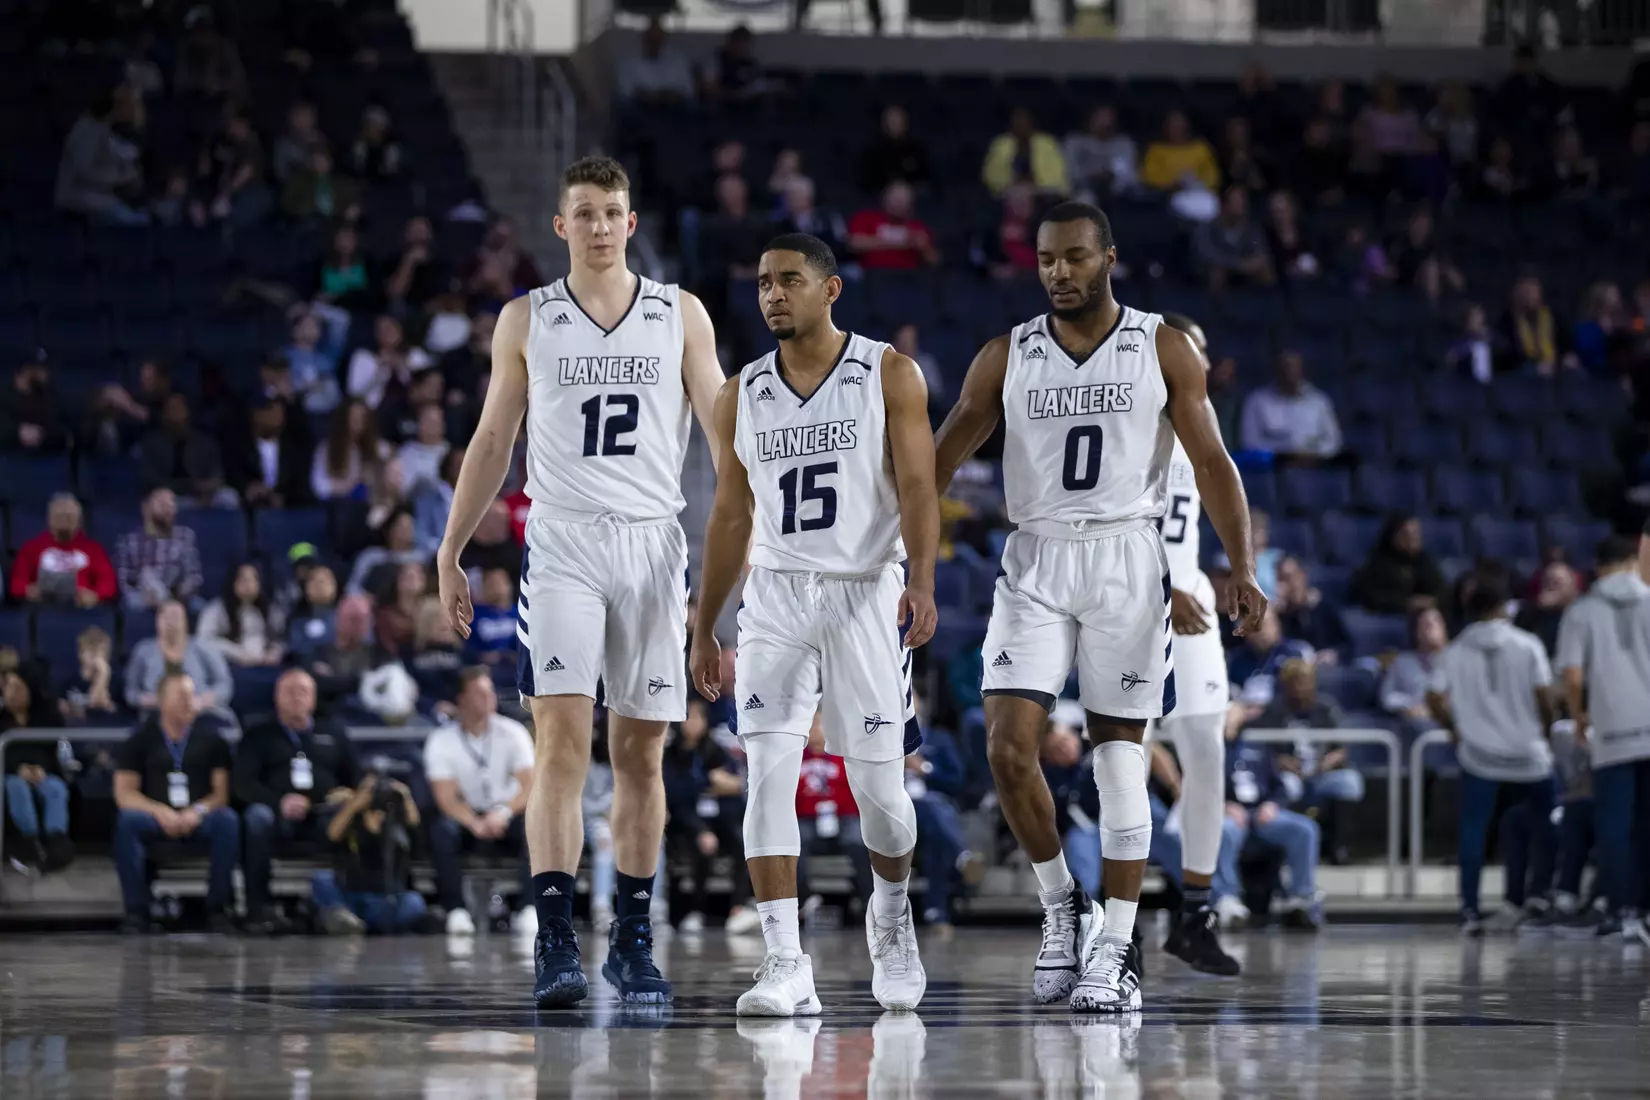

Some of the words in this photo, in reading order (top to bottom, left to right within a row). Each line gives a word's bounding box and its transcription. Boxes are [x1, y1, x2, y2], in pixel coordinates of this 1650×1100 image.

[643, 312, 664, 321] WAC
[1116, 343, 1139, 353] WAC
[558, 356, 659, 386] LANCERS
[841, 376, 863, 386] WAC
[1028, 383, 1132, 419] LANCERS
[581, 393, 639, 457] 12
[756, 419, 857, 462] LANCERS
[1062, 424, 1103, 491] 0
[779, 461, 838, 535] 15
[1150, 495, 1191, 543] 5
